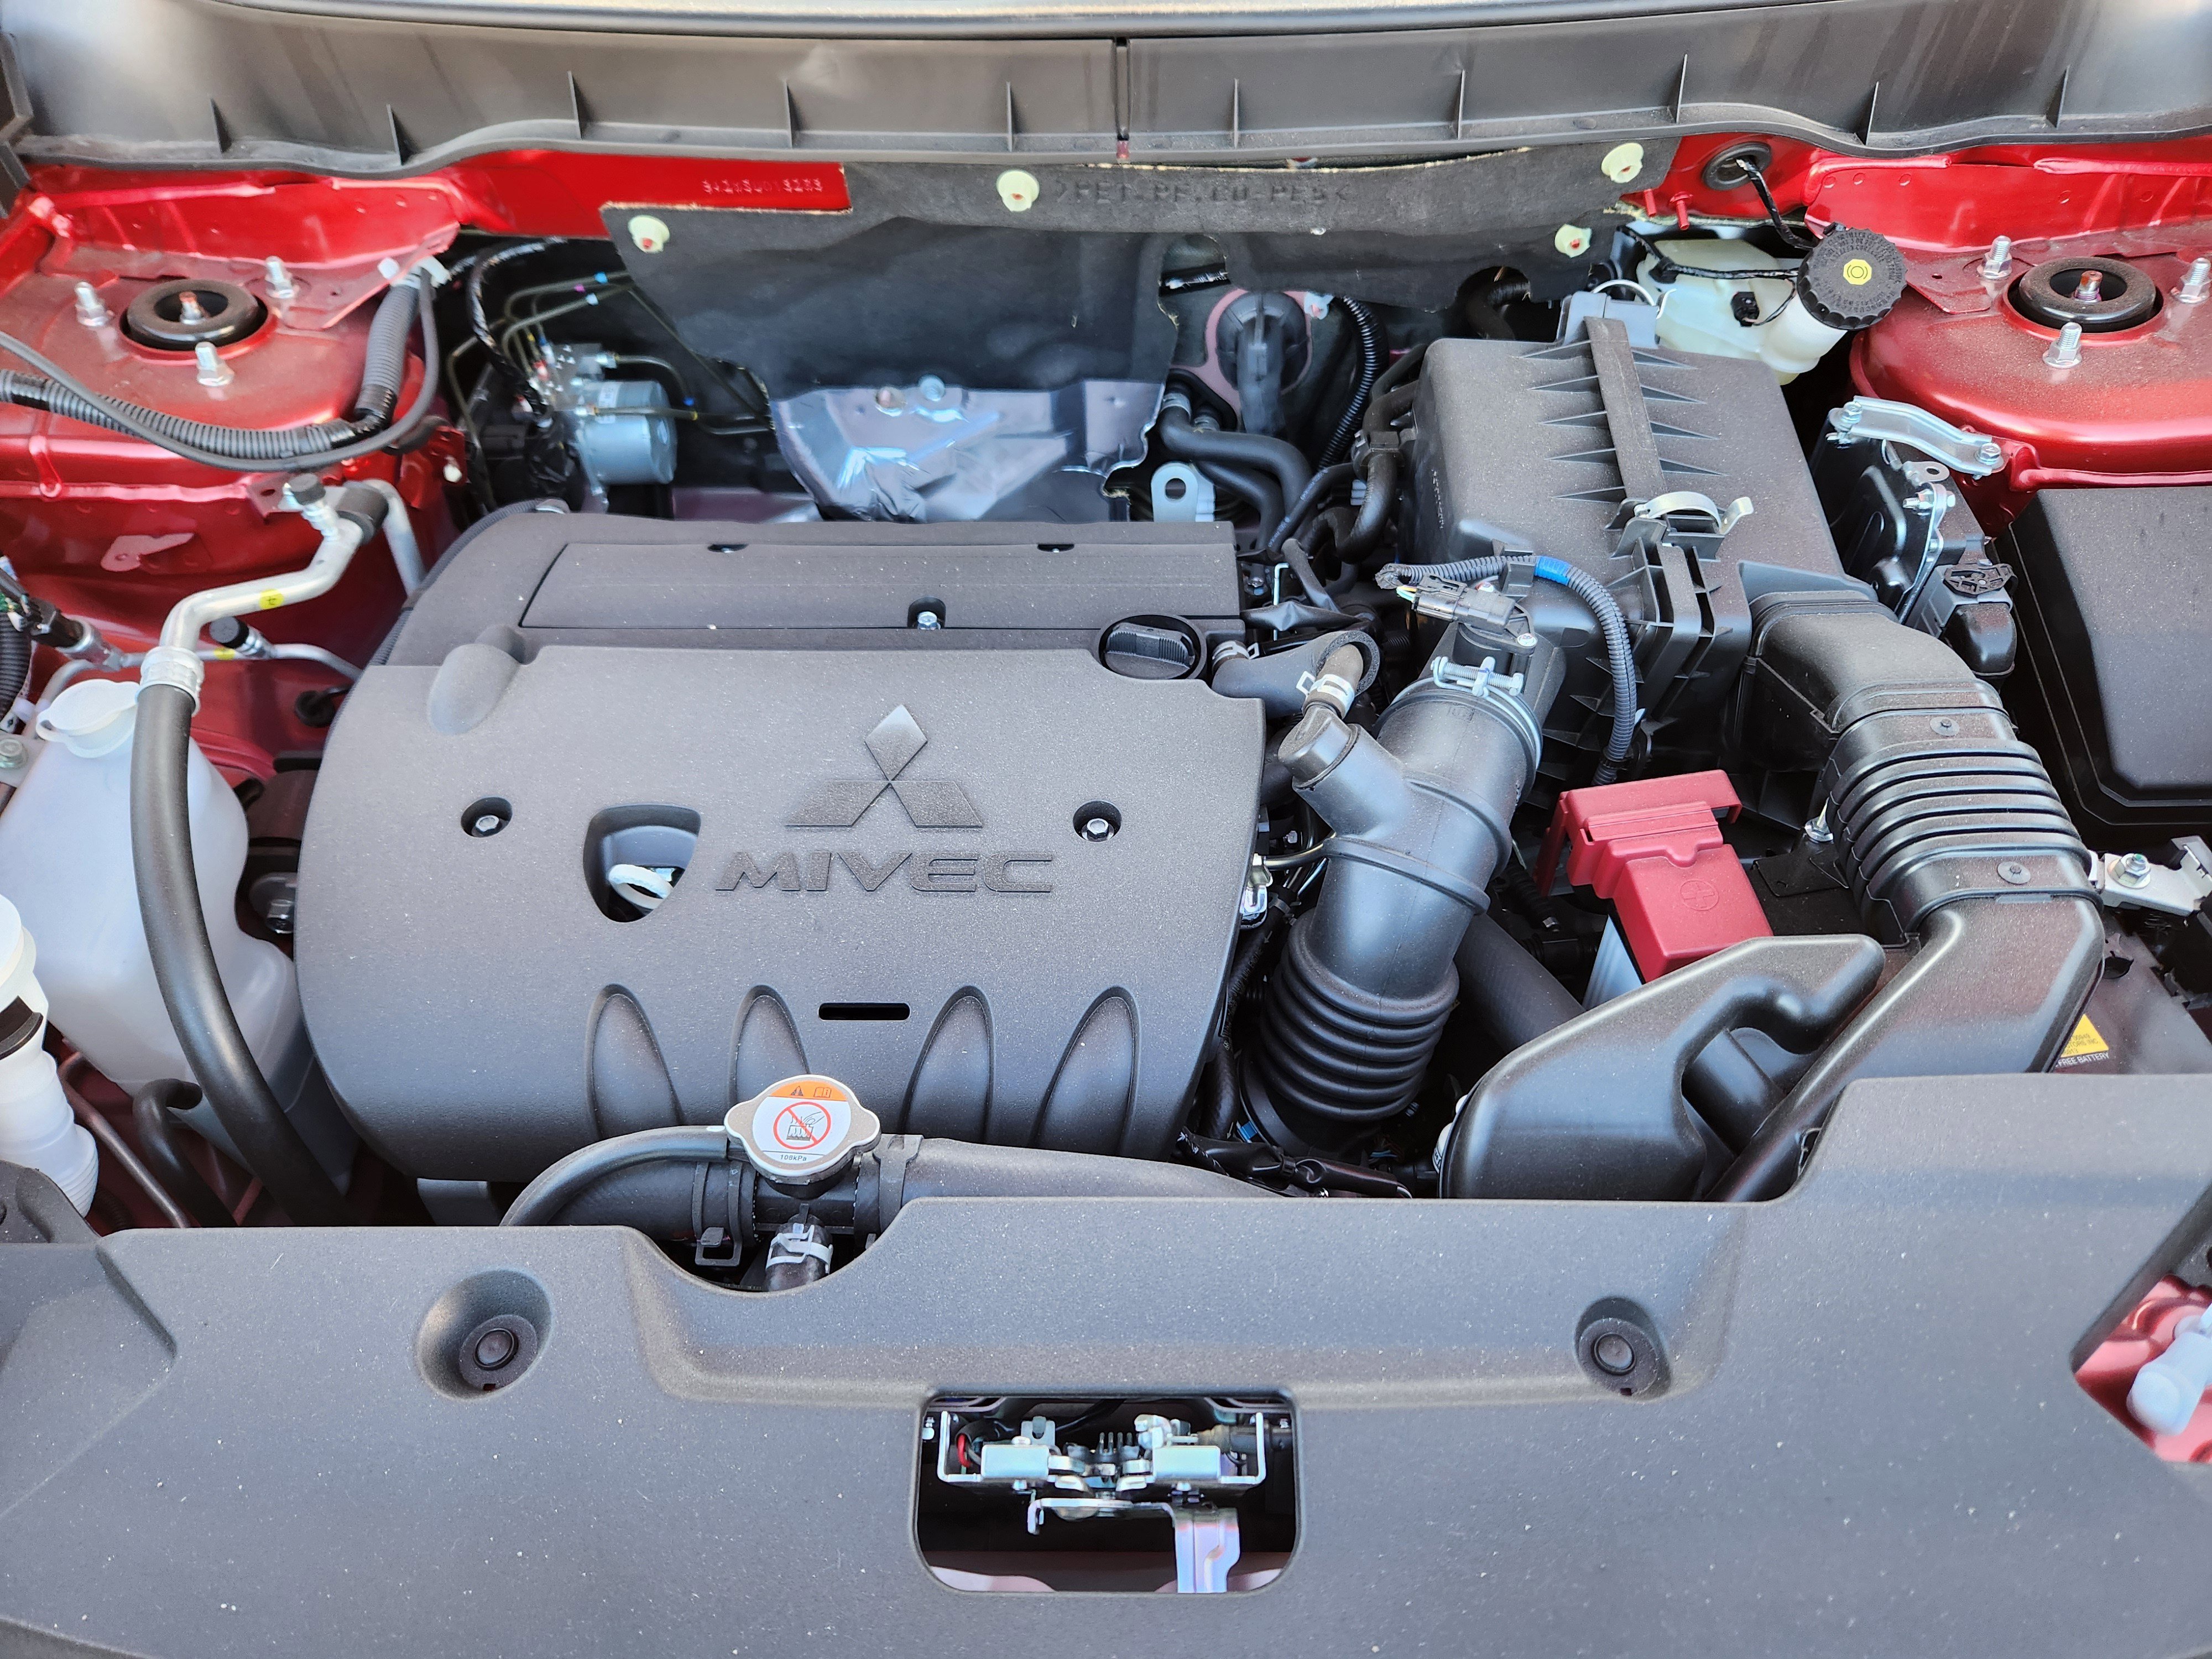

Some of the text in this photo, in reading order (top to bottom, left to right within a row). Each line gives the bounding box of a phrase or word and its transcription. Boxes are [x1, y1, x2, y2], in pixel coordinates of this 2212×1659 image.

[715, 852, 1053, 893] MIVEC
[2058, 1052, 2109, 1066] FREE BATTERY
